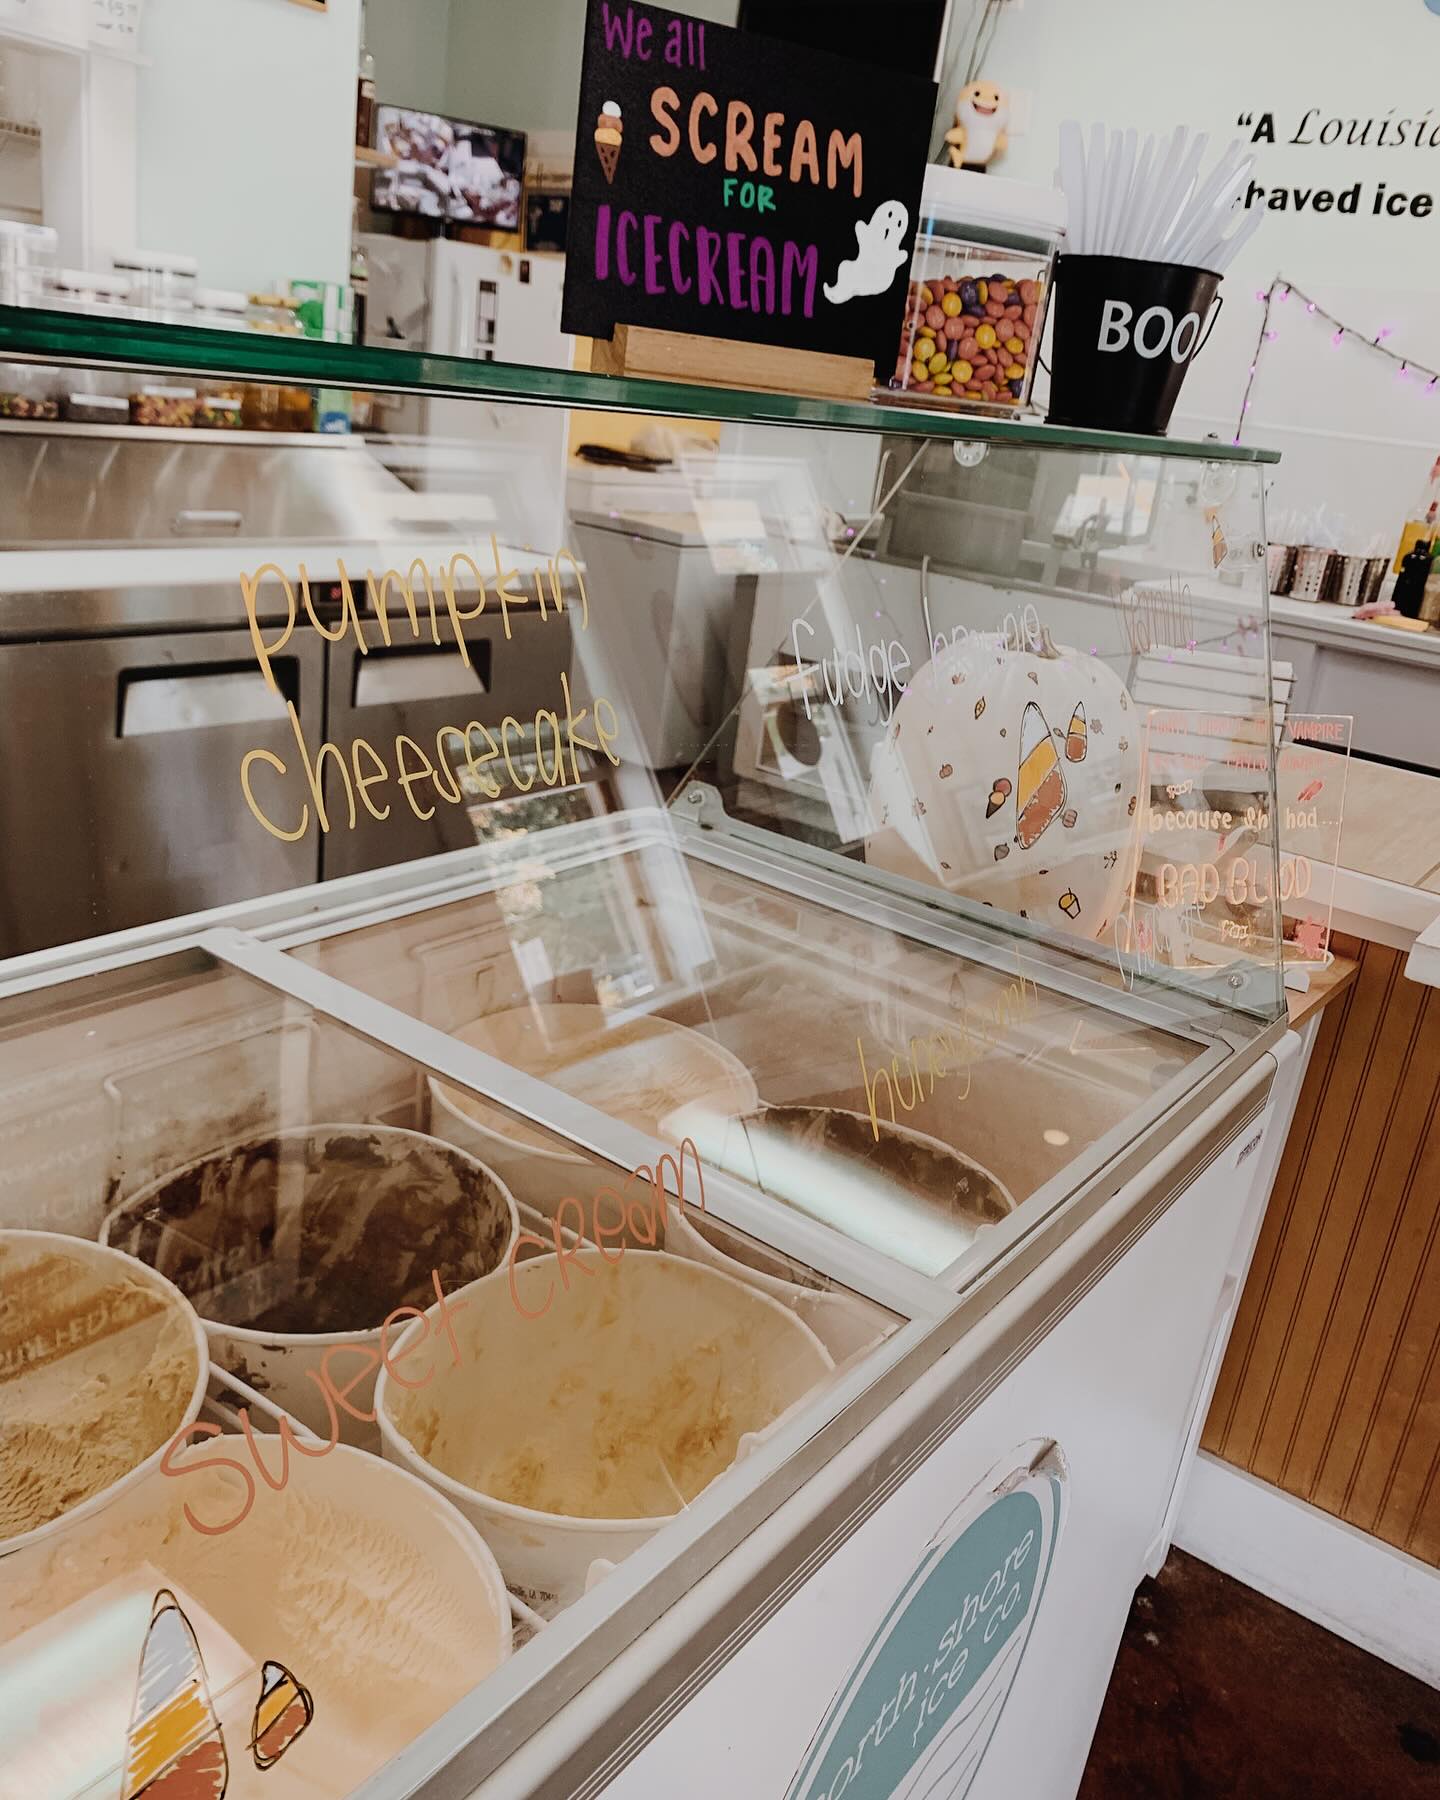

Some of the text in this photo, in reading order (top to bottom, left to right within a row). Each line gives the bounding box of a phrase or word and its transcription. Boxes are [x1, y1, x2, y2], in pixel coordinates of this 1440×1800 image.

[602, 3, 706, 71] We all
[650, 86, 863, 198] SCREAM
[723, 178, 776, 213] FOR
[1231, 180, 1434, 217] haved ice
[594, 205, 819, 318] ICECREAM
[1097, 300, 1201, 364] BOO
[240, 533, 590, 693] pumpkin
[240, 672, 620, 842] cheesecake
[1287, 720, 1344, 741] VAMPIRE
[1150, 808, 1233, 832] because
[1160, 863, 1220, 908] BAD
[911, 1582, 1022, 1748] ice co.
